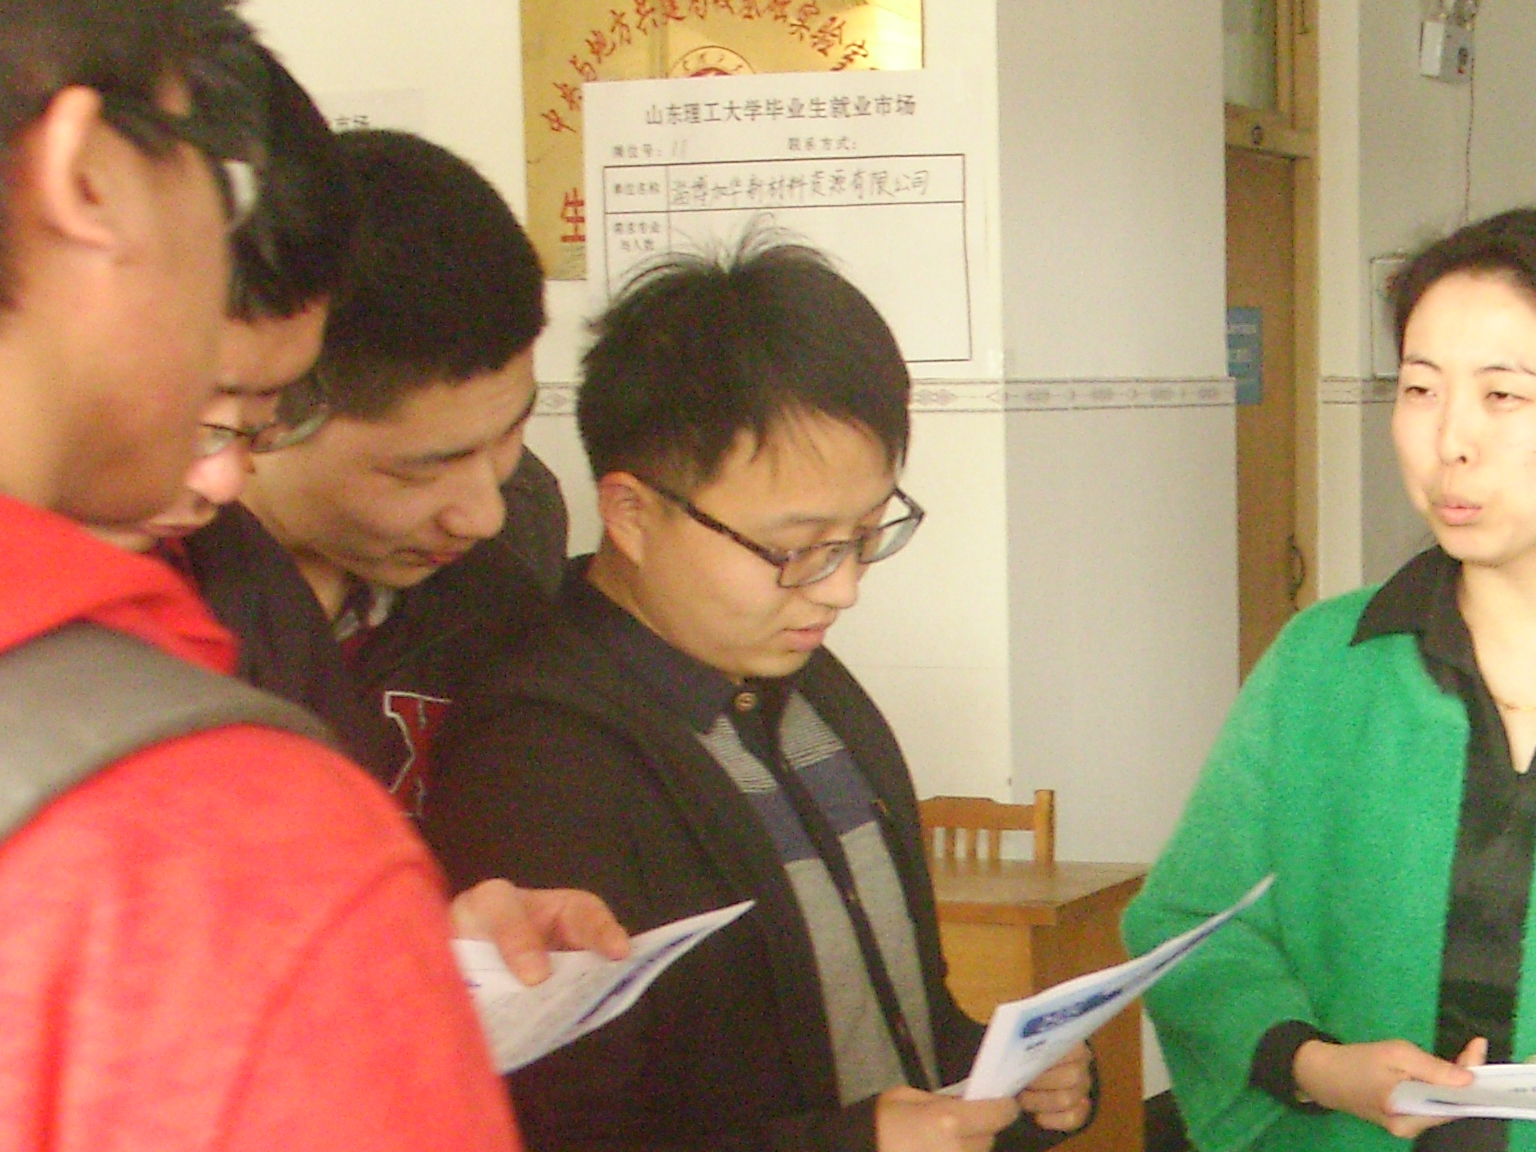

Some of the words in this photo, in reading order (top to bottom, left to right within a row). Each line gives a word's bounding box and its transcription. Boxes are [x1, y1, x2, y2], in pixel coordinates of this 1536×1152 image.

[645, 94, 917, 126] 山东理工大学毕业生就业市场
